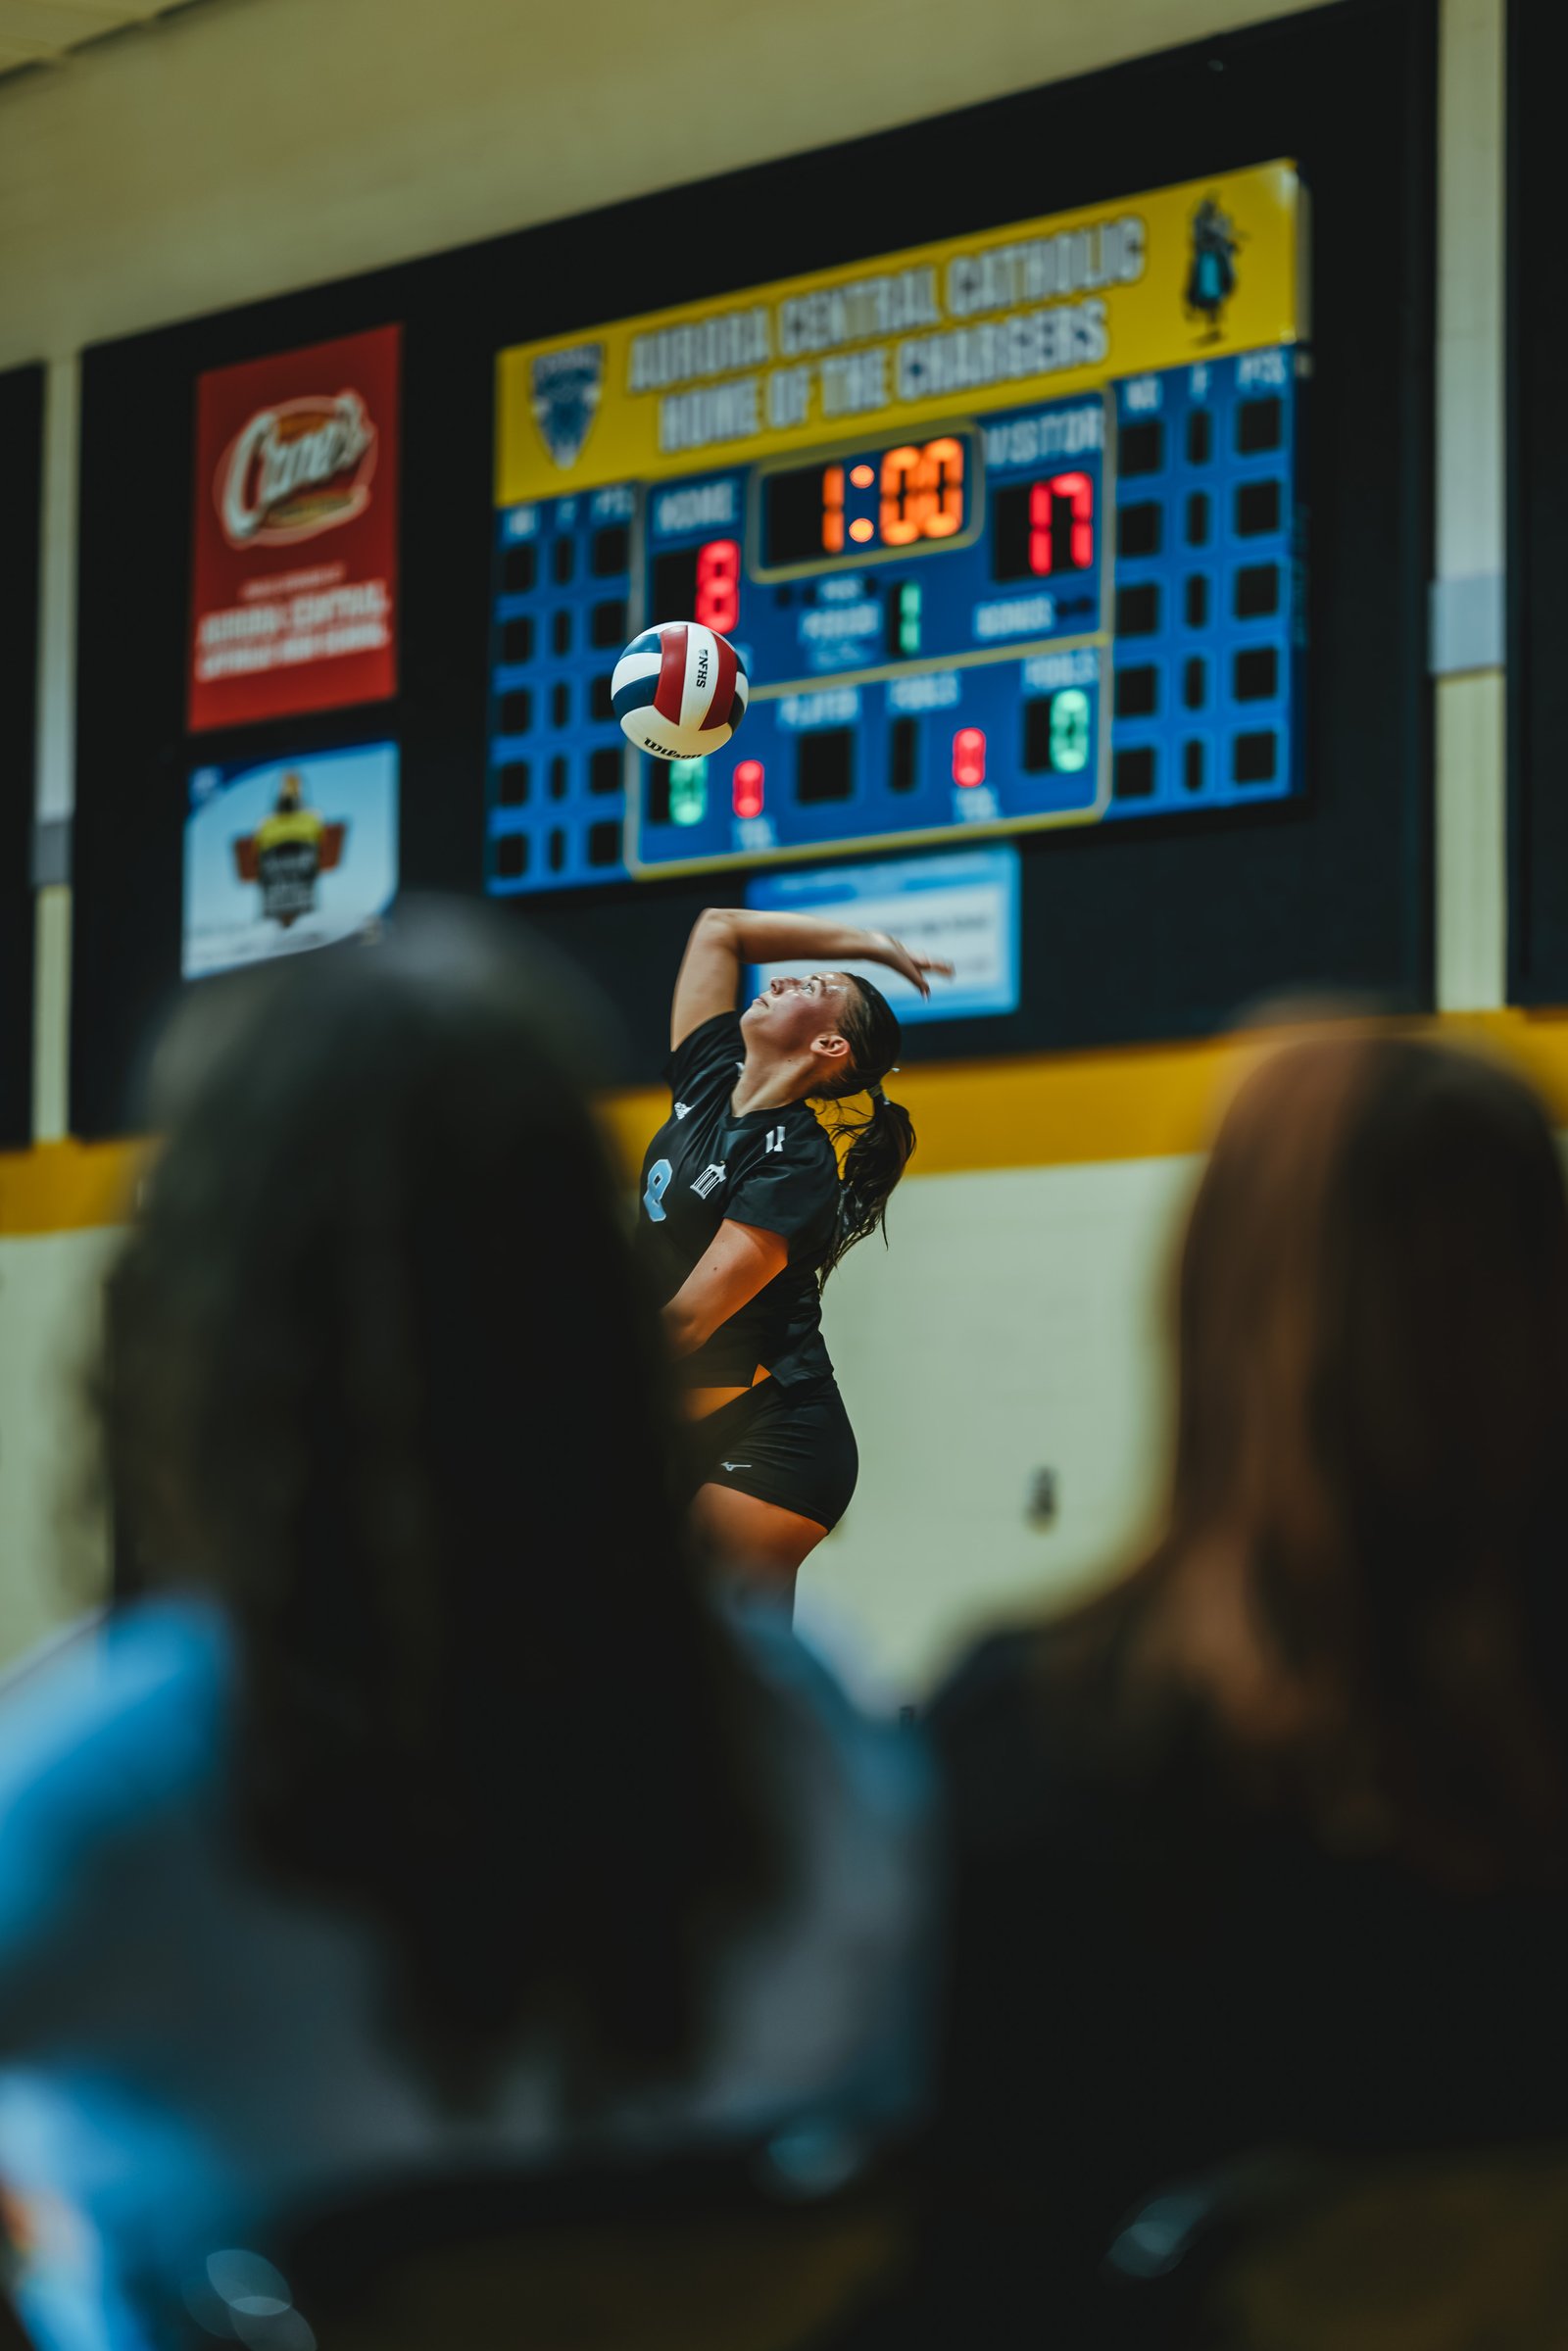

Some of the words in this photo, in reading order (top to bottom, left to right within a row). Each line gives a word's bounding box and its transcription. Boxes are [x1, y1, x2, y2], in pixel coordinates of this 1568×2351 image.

[628, 305, 769, 392] AURORA
[778, 266, 939, 356] CENTRAL
[948, 216, 1145, 318] CATHOLIC
[659, 376, 759, 453] HOME
[766, 366, 808, 427] OF
[820, 348, 888, 416] THE
[899, 297, 1107, 400] CHARGERS
[985, 406, 1103, 465] VISITOR
[822, 437, 963, 553] 1:00
[1029, 471, 1094, 576] 17
[696, 539, 741, 634] 8
[900, 581, 922, 655] 1
[696, 656, 708, 688] NFHS
[644, 736, 703, 759] Wilson
[1050, 688, 1091, 772] 0
